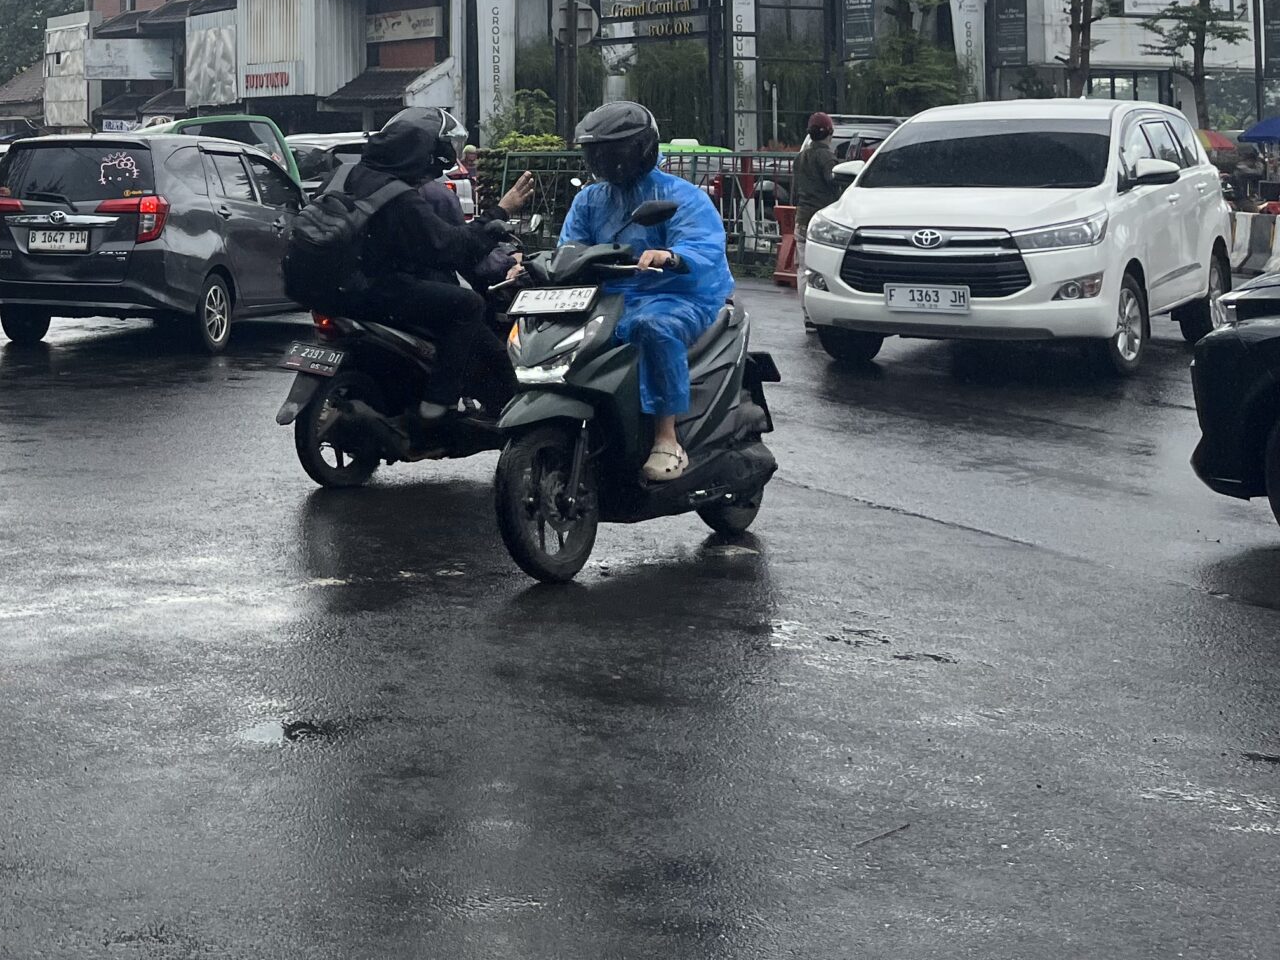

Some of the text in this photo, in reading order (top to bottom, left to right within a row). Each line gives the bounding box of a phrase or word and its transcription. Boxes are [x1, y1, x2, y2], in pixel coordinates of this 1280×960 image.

[611, 1, 645, 17] Grand
[648, 21, 692, 36] BOGOR
[491, 6, 500, 113] GROUNDBREAK
[31, 231, 88, 244] B 1647 PIW
[520, 292, 529, 301] F
[889, 288, 966, 304] F 1363 JH
[289, 345, 299, 355] F
[301, 348, 325, 360] 2397
